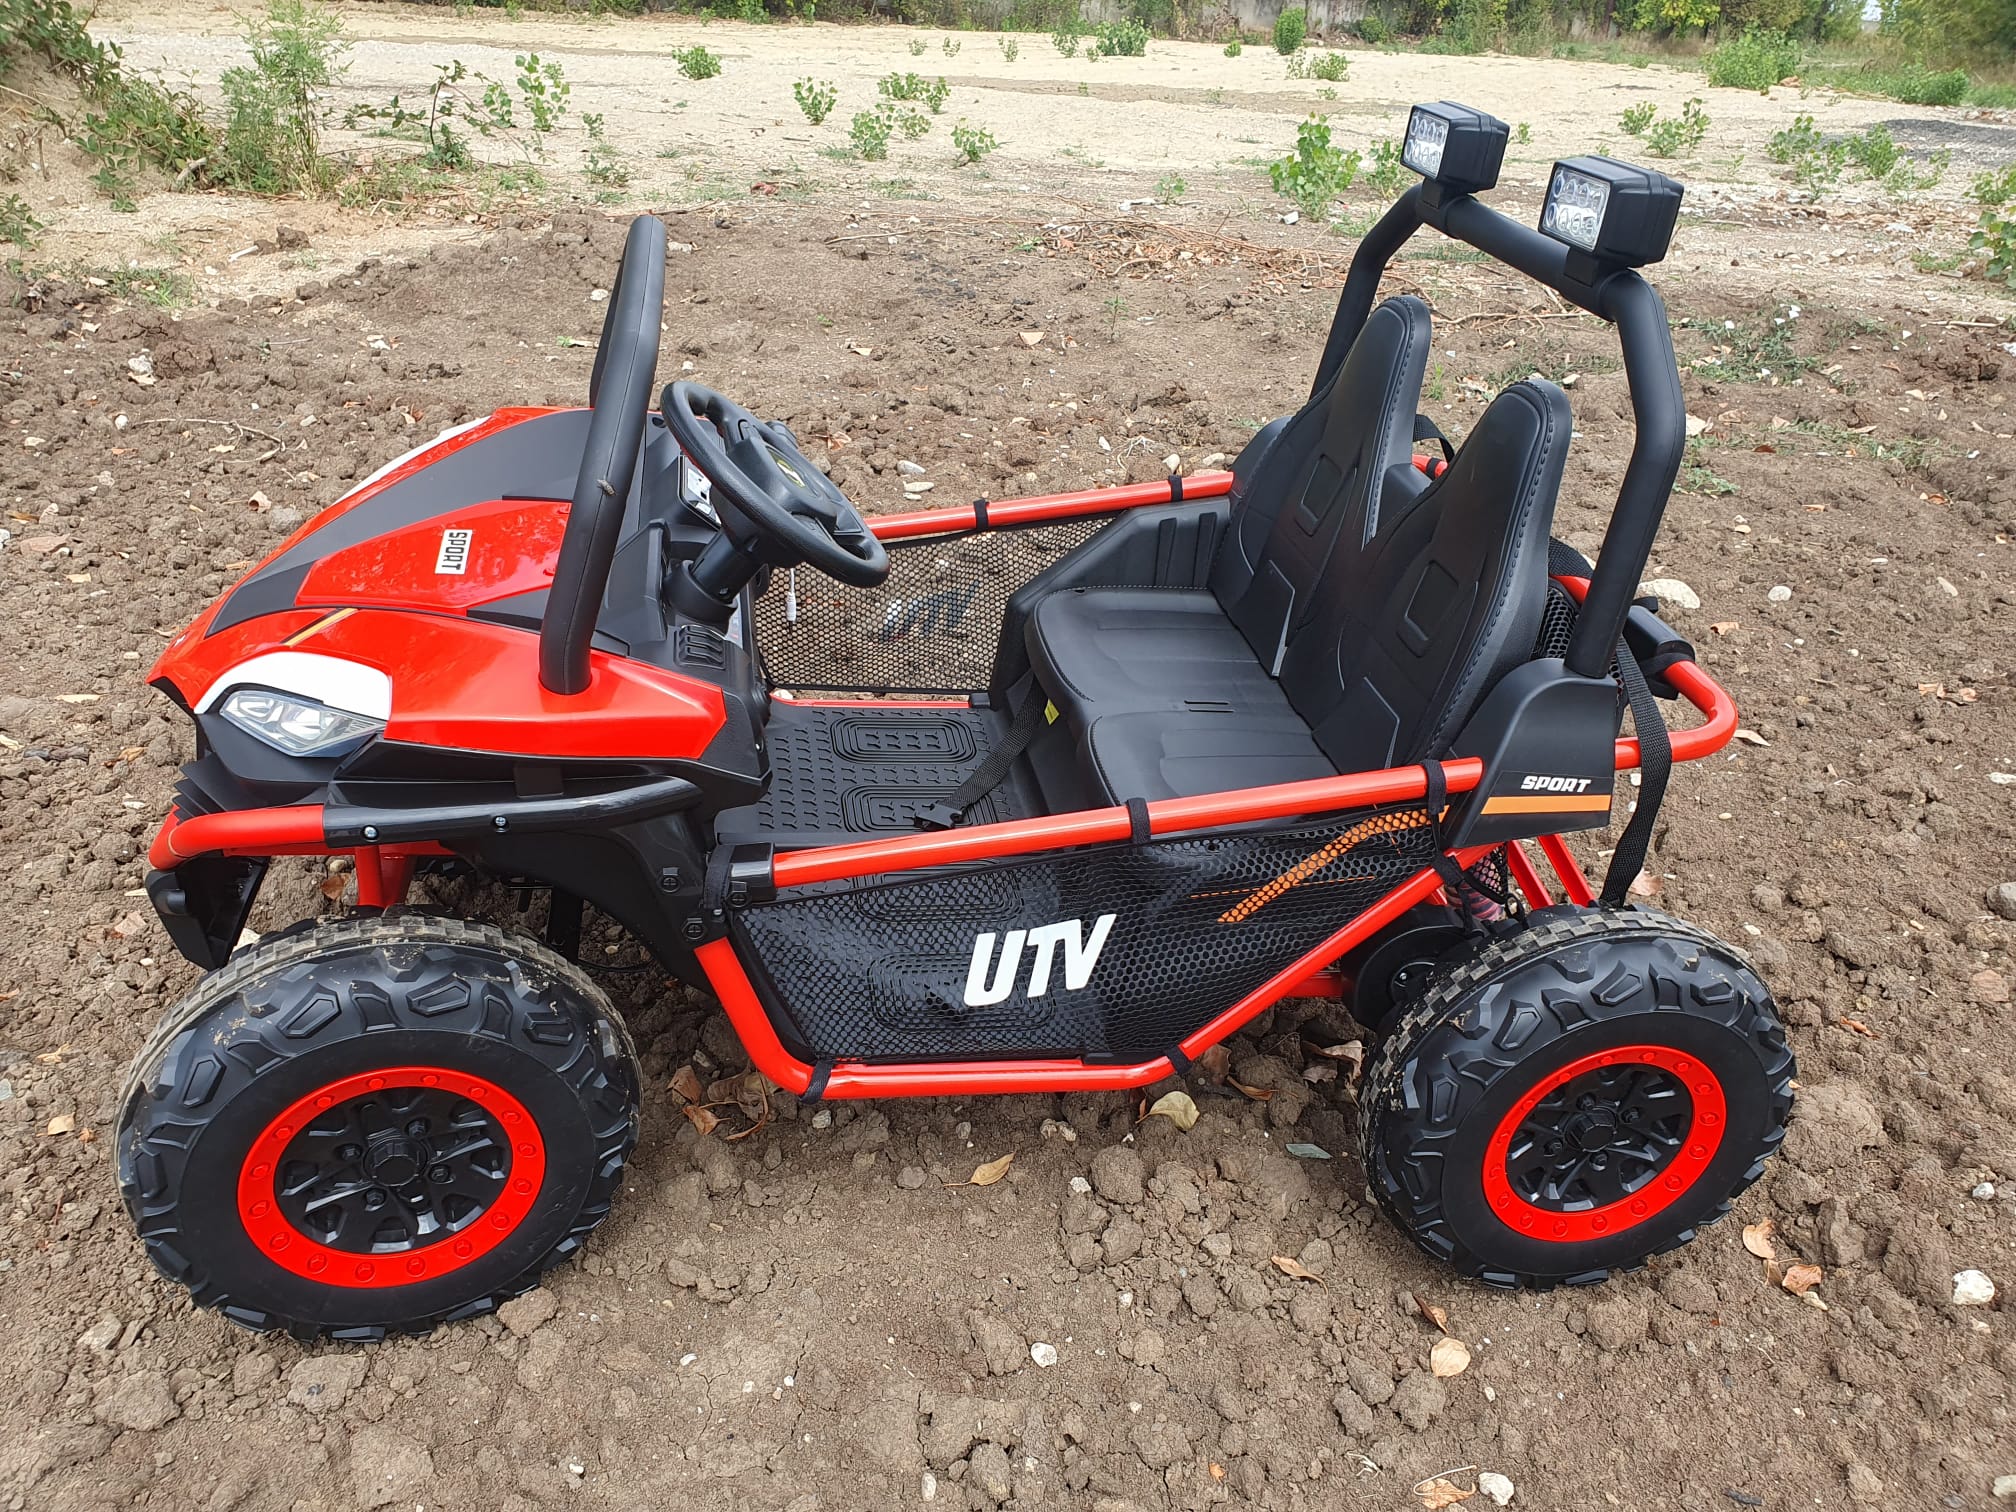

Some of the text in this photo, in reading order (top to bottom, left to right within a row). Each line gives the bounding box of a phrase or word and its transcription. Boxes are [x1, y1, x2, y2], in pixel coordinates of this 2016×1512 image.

[441, 532, 468, 570] SPORT
[1520, 775, 1592, 793] SPORT
[963, 913, 1117, 1007] UTV
